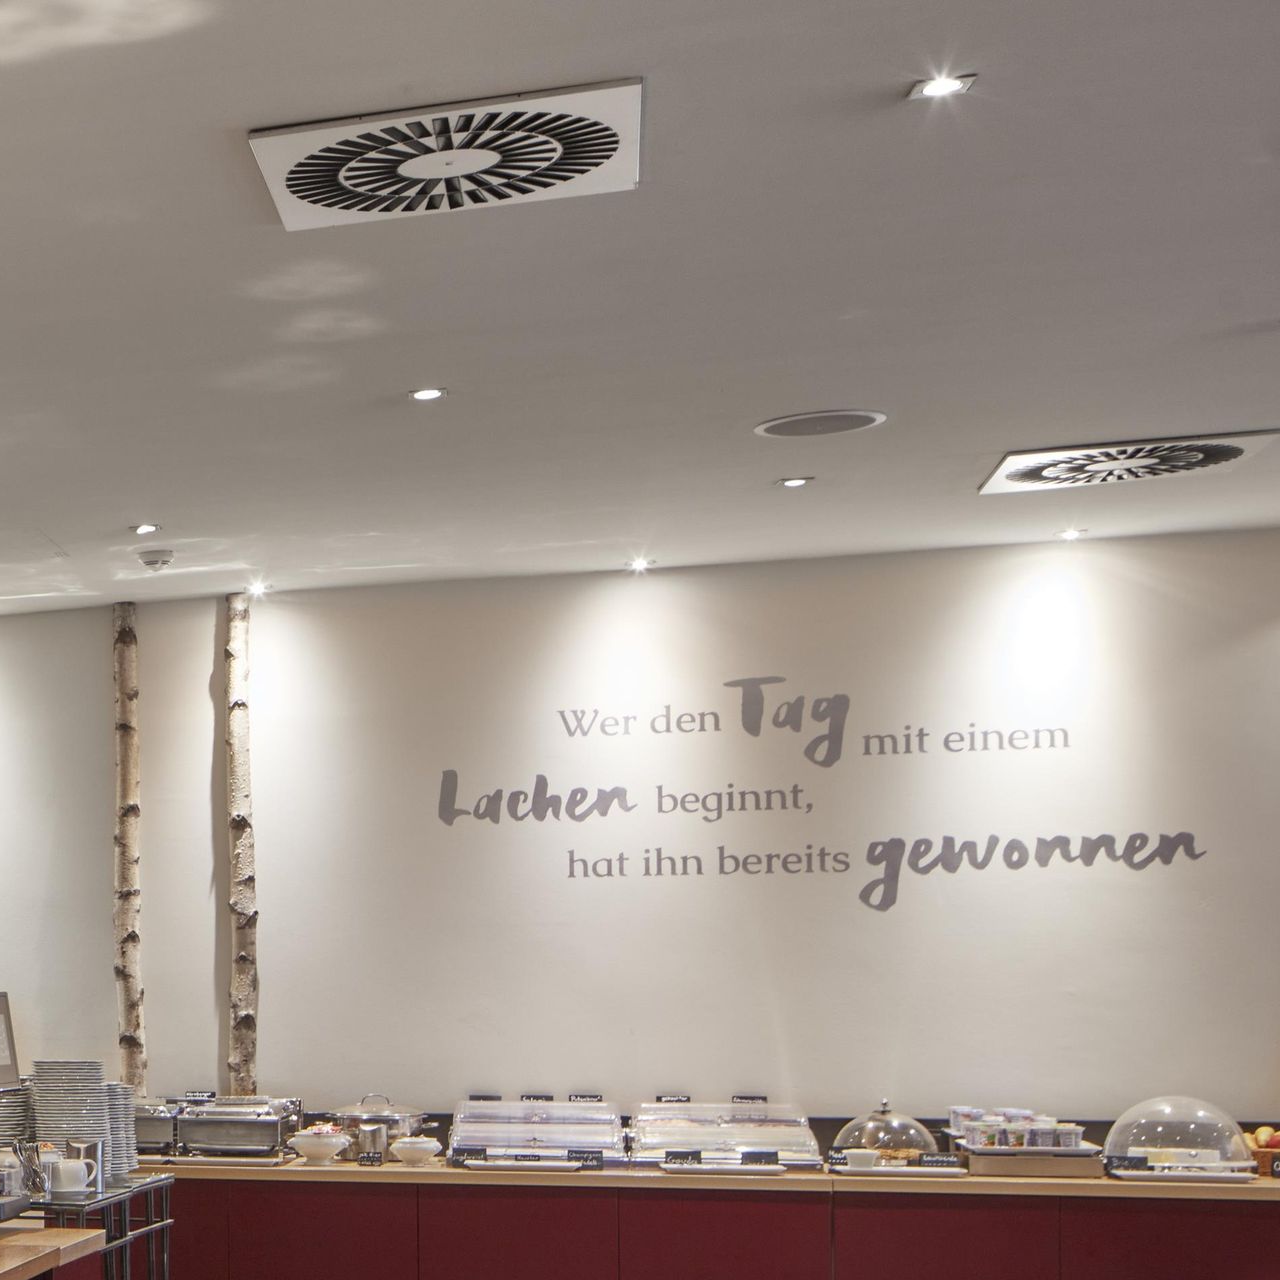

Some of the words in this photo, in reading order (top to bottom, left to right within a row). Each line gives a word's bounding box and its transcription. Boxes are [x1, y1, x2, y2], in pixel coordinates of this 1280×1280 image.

[557, 709, 637, 738] Wer
[650, 704, 721, 734] den
[723, 676, 851, 768] Tag
[862, 724, 930, 756] mit
[942, 722, 1070, 753] einem
[438, 769, 637, 826] Lachen
[656, 783, 813, 824] beginnt,
[567, 849, 630, 879] hat
[642, 847, 704, 877] ihn
[717, 844, 851, 876] bereits
[858, 831, 1207, 912] gewonnen
